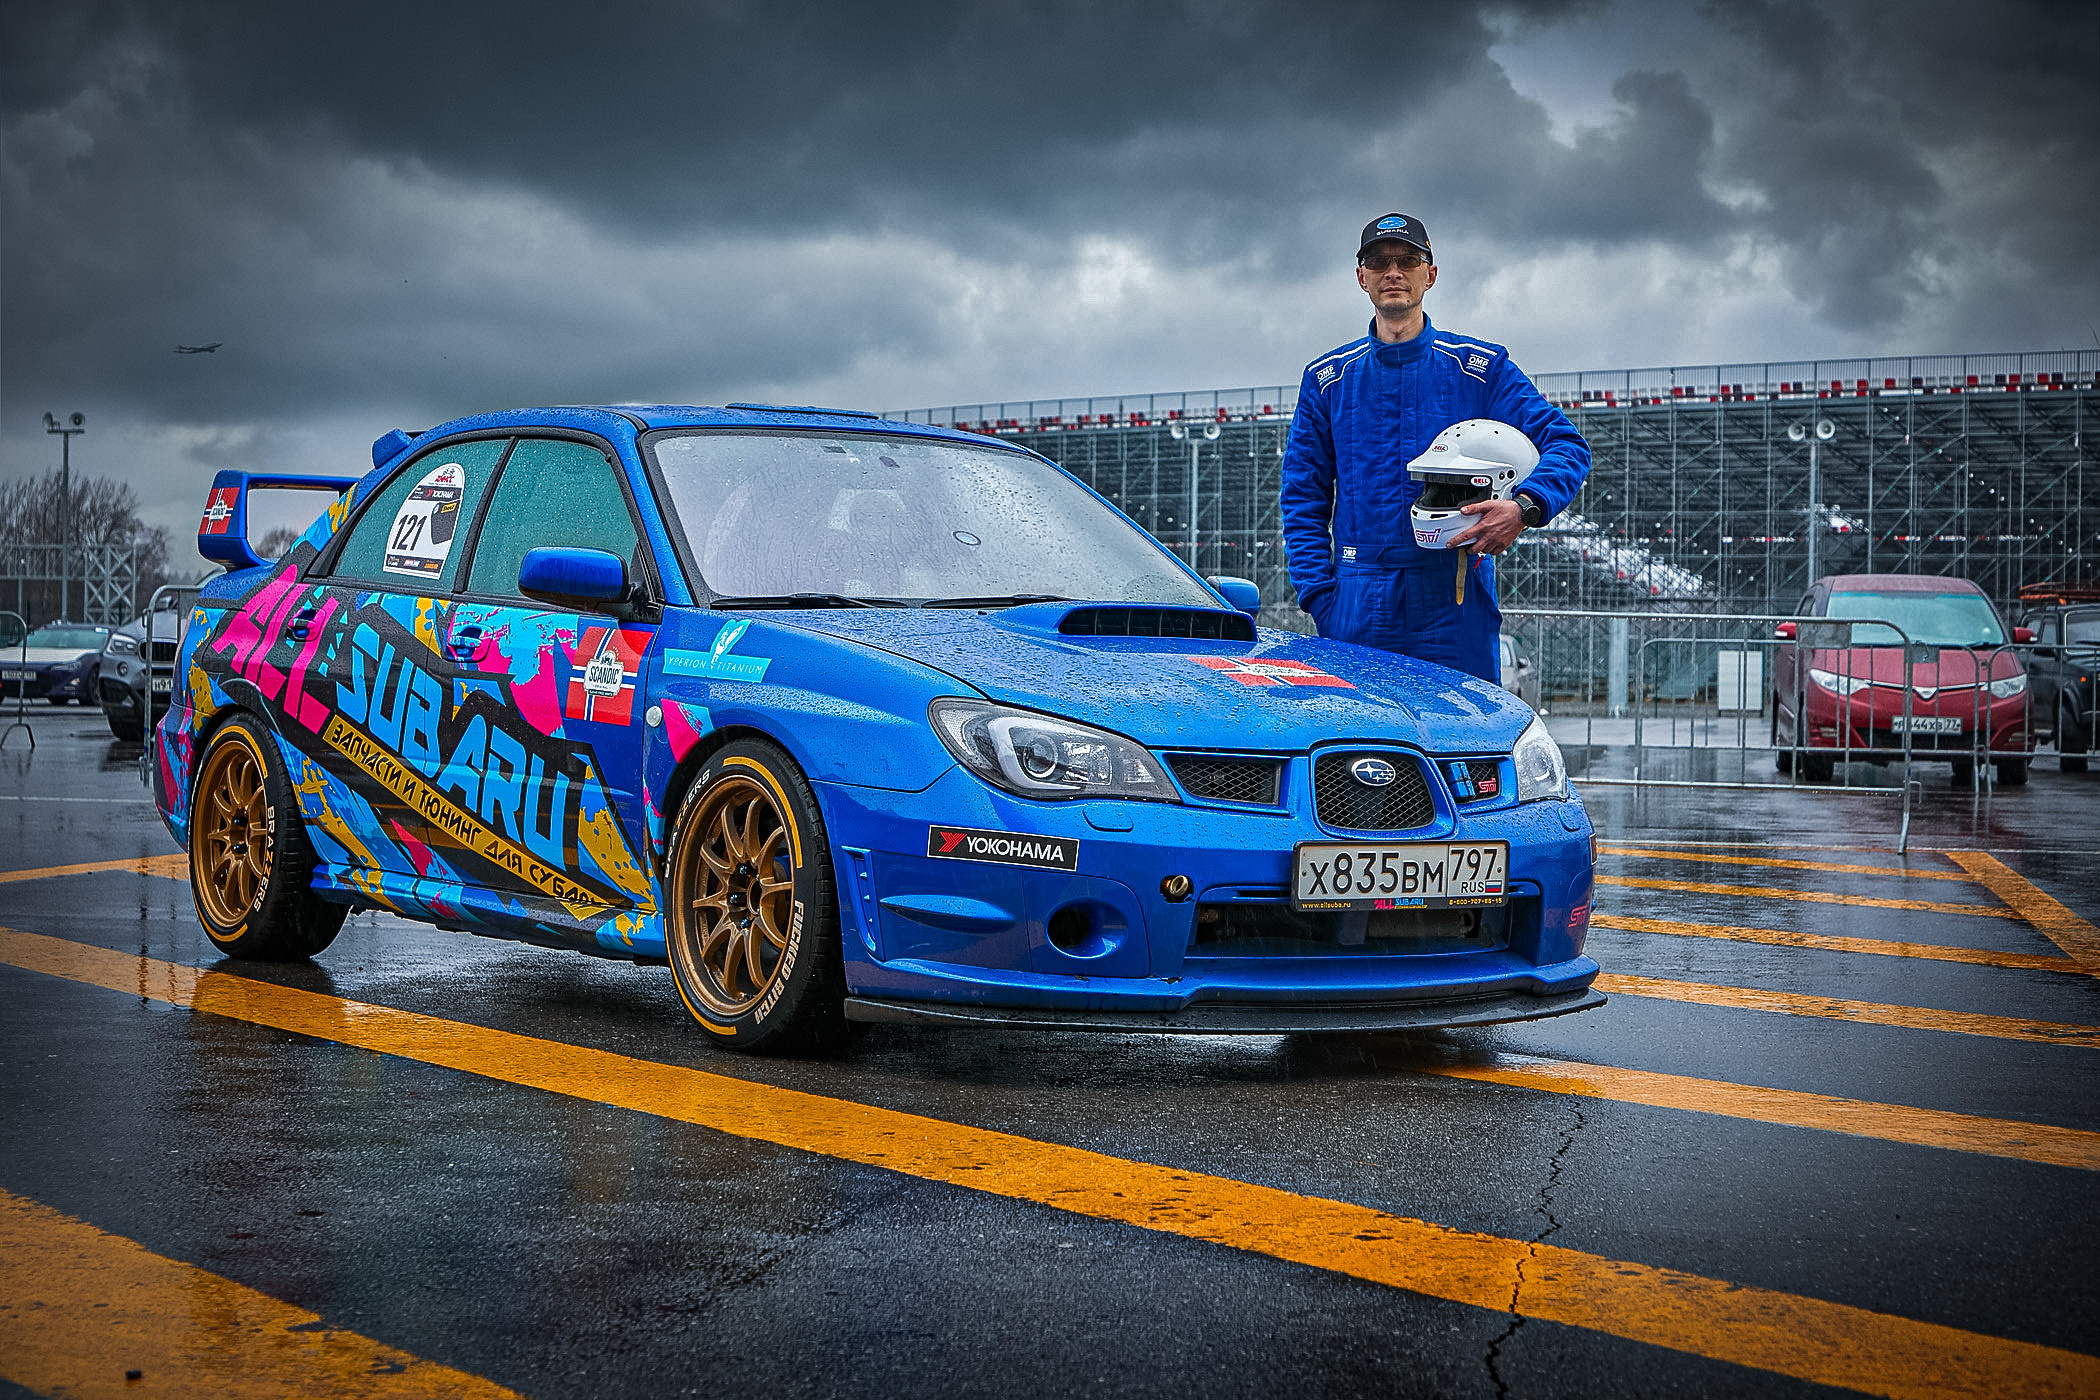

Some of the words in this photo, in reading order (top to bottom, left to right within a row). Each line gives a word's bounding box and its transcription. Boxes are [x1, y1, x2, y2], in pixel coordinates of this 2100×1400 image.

[1317, 366, 1334, 380] OMP
[1469, 356, 1489, 367] OMP
[392, 514, 428, 551] 121
[589, 666, 620, 684] SCANDIC
[717, 661, 763, 674] TITANIUM
[335, 622, 568, 872] SUBARU
[331, 723, 402, 790] ЗАПЧАСТИ
[403, 784, 417, 801] И
[420, 788, 482, 846] ТЮНИНГ
[484, 840, 522, 875] ДЛЯ
[529, 864, 599, 905] СУБАР
[254, 806, 275, 912] BRAZZERS
[967, 836, 1064, 862] YOKOHAMA
[1450, 848, 1498, 881] 797
[1461, 881, 1484, 893] RUS
[781, 900, 804, 981] FUCKED
[753, 977, 785, 1025] BITCH
